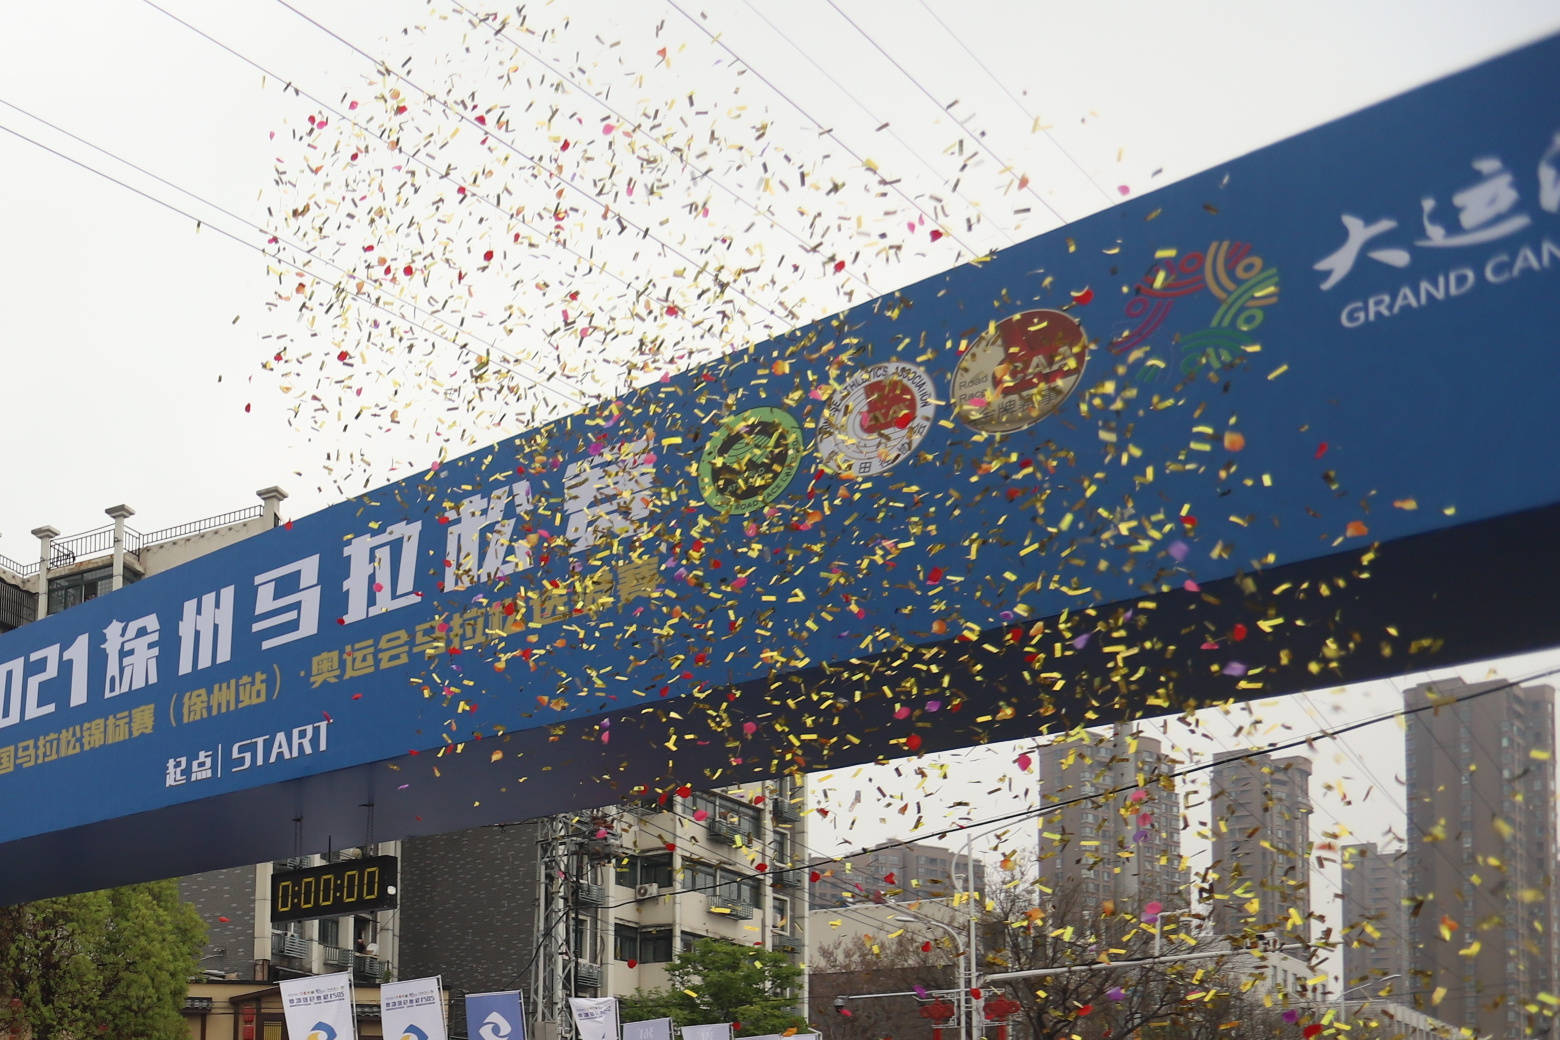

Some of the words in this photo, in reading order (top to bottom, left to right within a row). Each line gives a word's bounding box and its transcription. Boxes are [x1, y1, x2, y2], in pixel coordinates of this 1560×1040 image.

[1340, 268, 1476, 328] GRAND
[165, 748, 213, 788] 起点
[231, 718, 333, 773] START
[279, 866, 379, 912] 0:00:00
